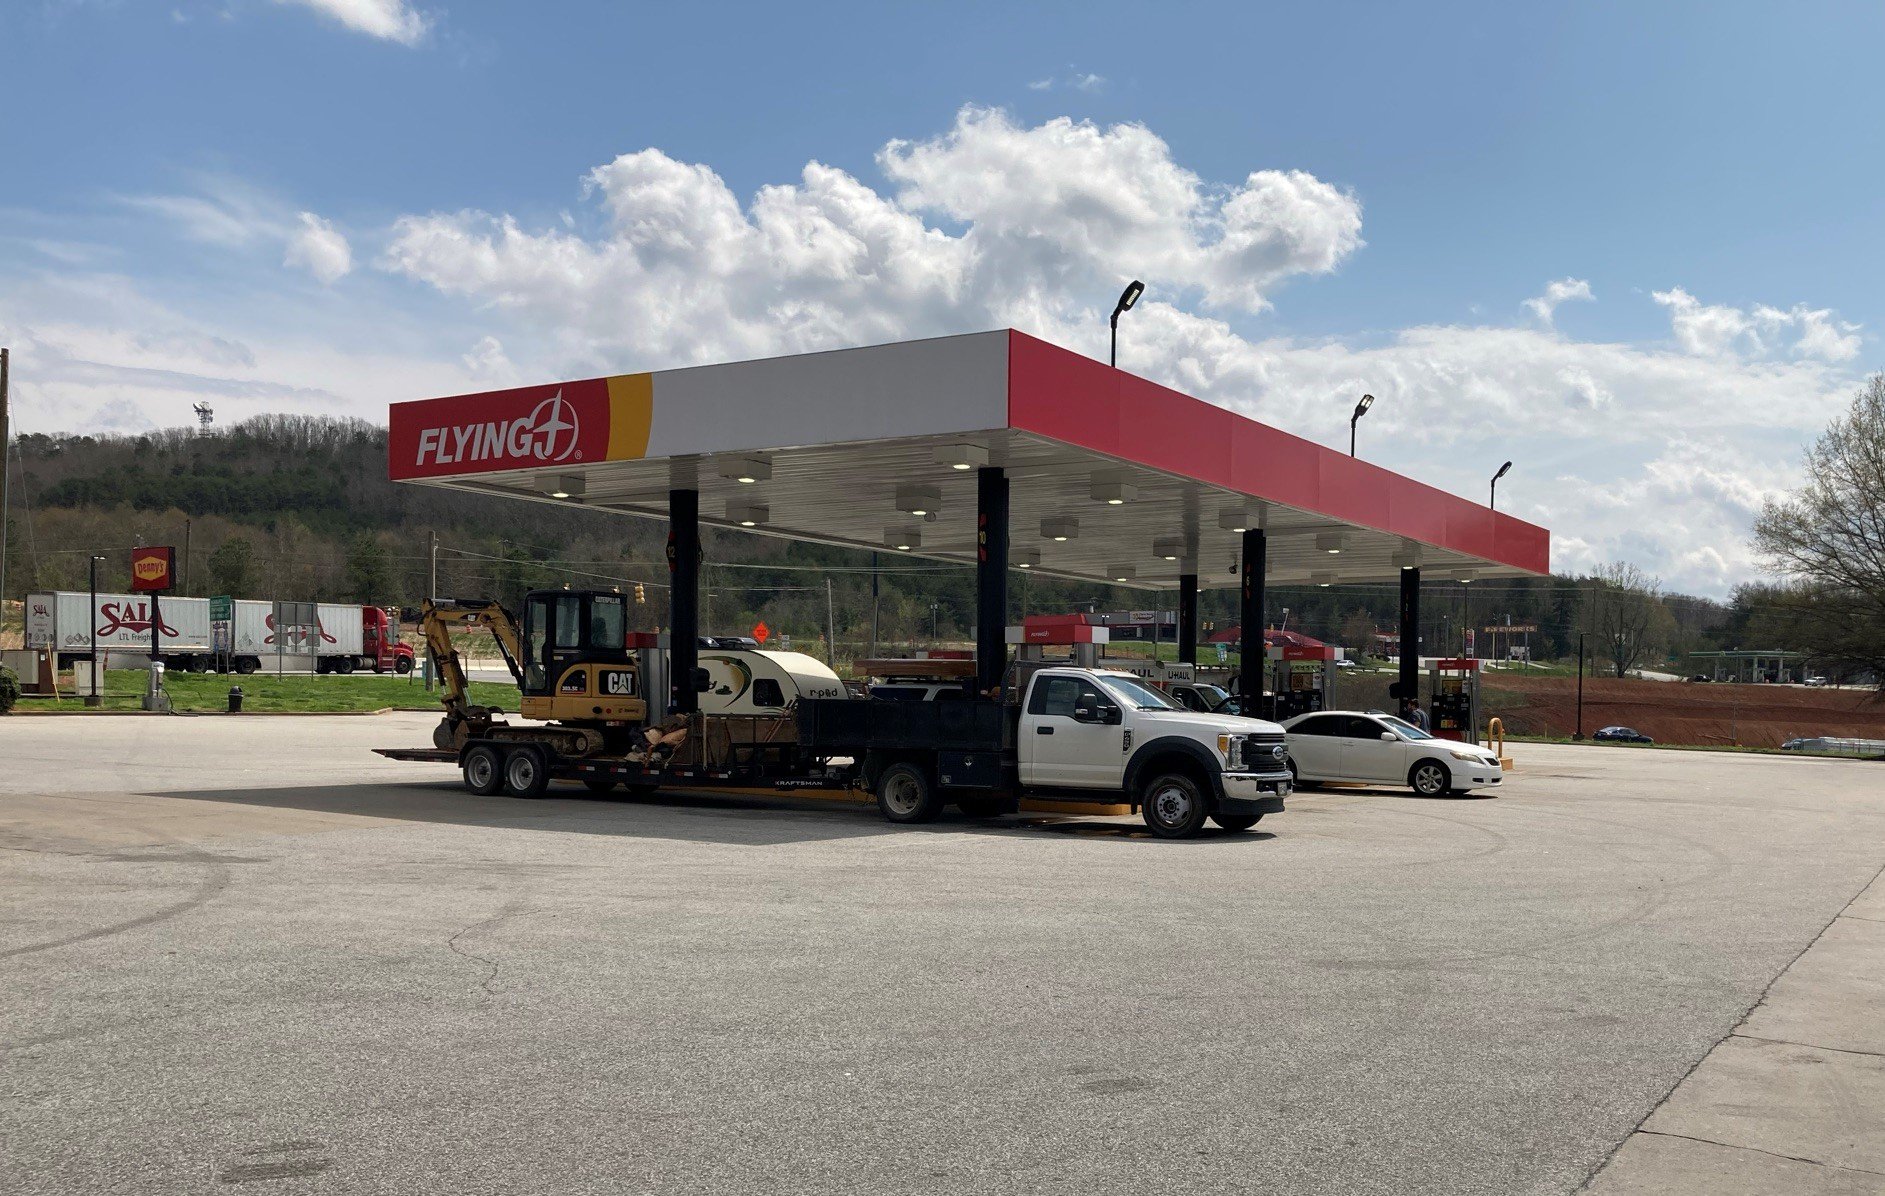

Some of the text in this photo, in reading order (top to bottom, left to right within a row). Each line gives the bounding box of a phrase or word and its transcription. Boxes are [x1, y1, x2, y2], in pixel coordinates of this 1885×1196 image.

[137, 561, 164, 574] Denny's
[119, 632, 152, 643] LTL Freigh
[1130, 668, 1155, 678] AUL
[607, 672, 633, 694] CAT
